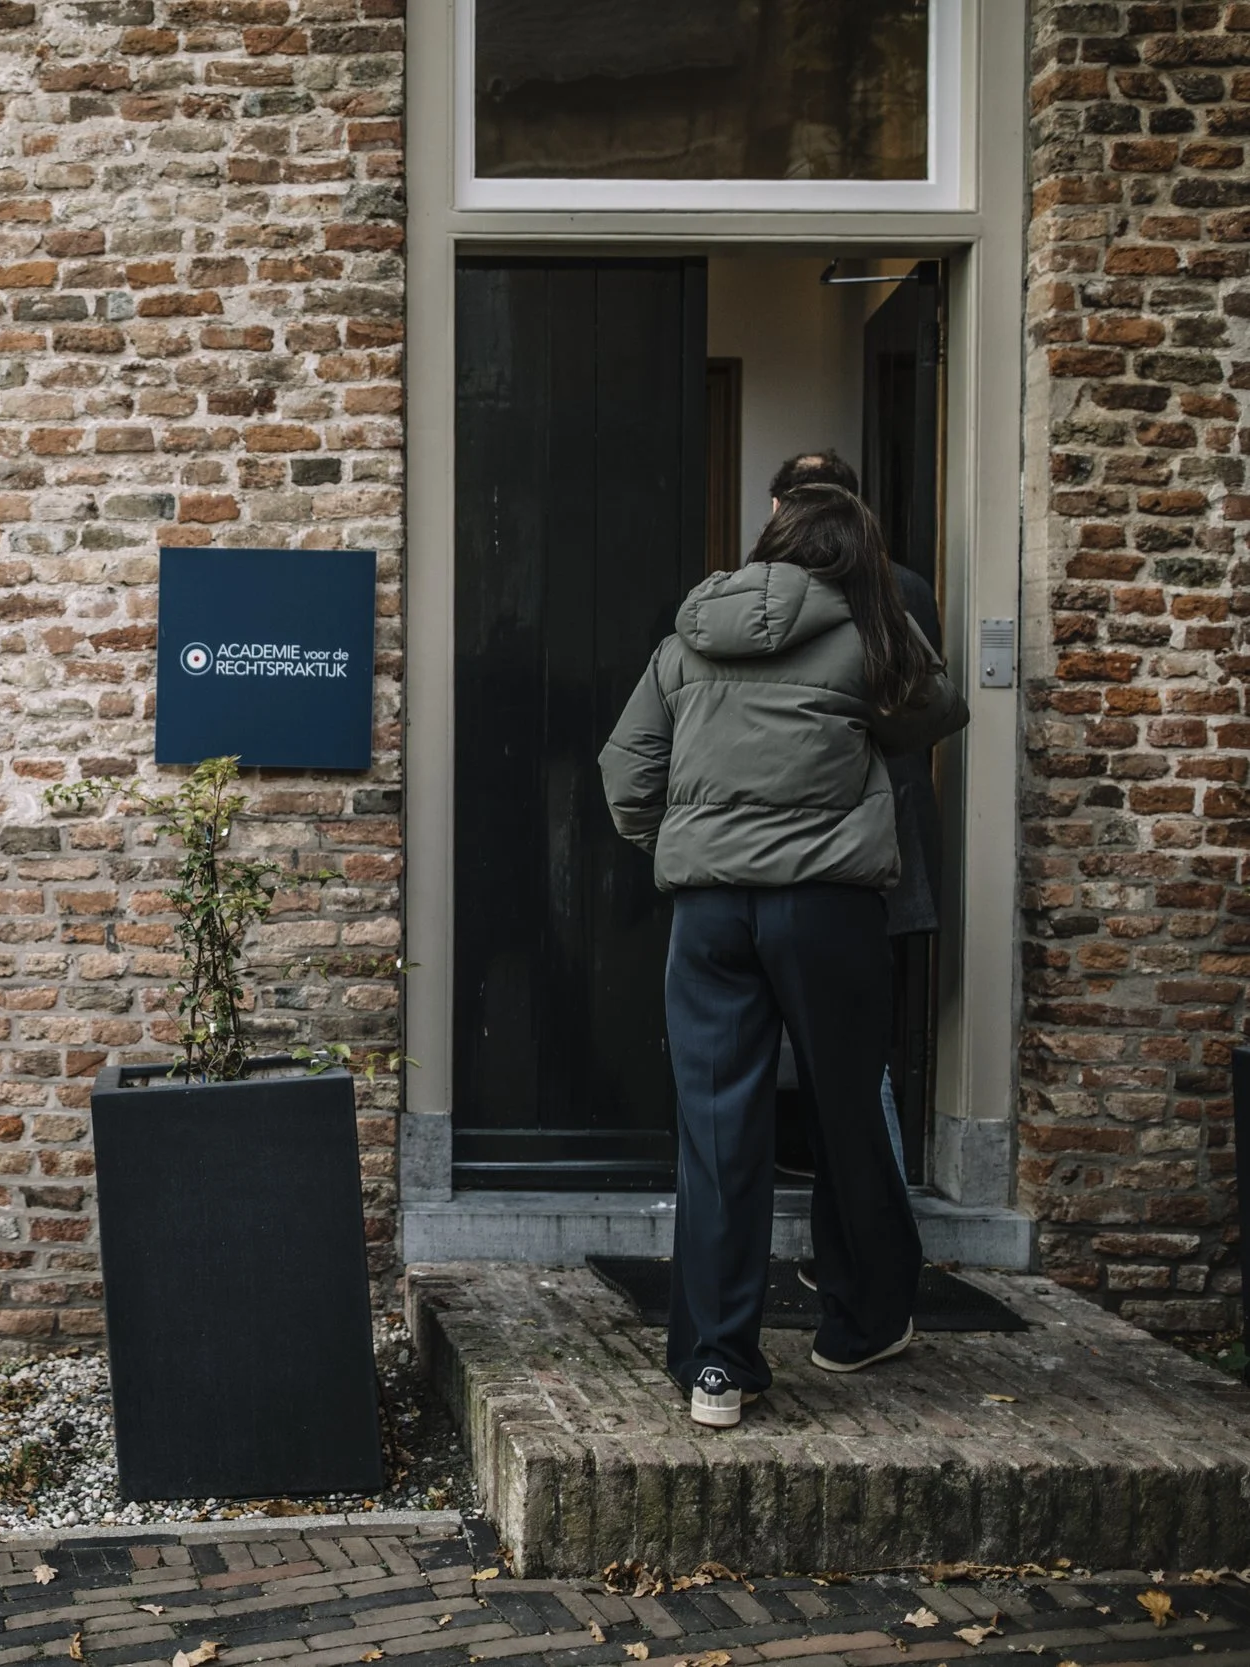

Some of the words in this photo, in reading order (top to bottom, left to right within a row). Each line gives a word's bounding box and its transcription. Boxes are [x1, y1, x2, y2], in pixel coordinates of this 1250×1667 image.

[216, 644, 300, 660] ACADEMIE
[304, 650, 330, 660] voor
[332, 648, 349, 661] de
[216, 661, 348, 678] RECHTSPRAKTIJK
